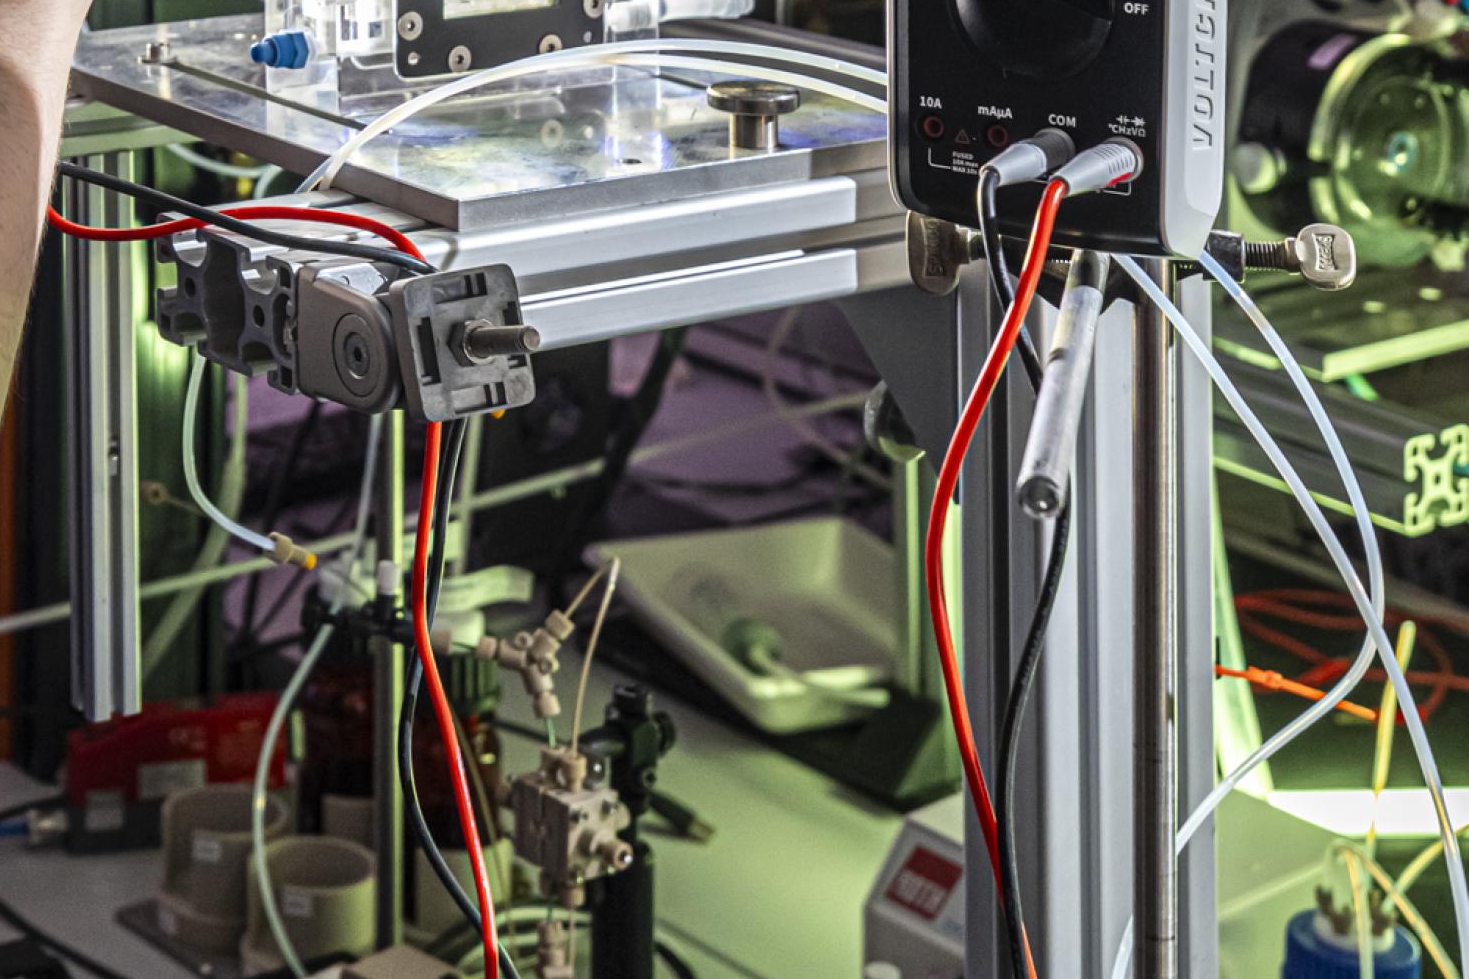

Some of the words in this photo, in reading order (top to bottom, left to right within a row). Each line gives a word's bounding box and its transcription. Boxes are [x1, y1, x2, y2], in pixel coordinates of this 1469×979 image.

[1124, 2, 1149, 15] OFF
[919, 96, 942, 109] 10A
[1048, 113, 1076, 128] COM
